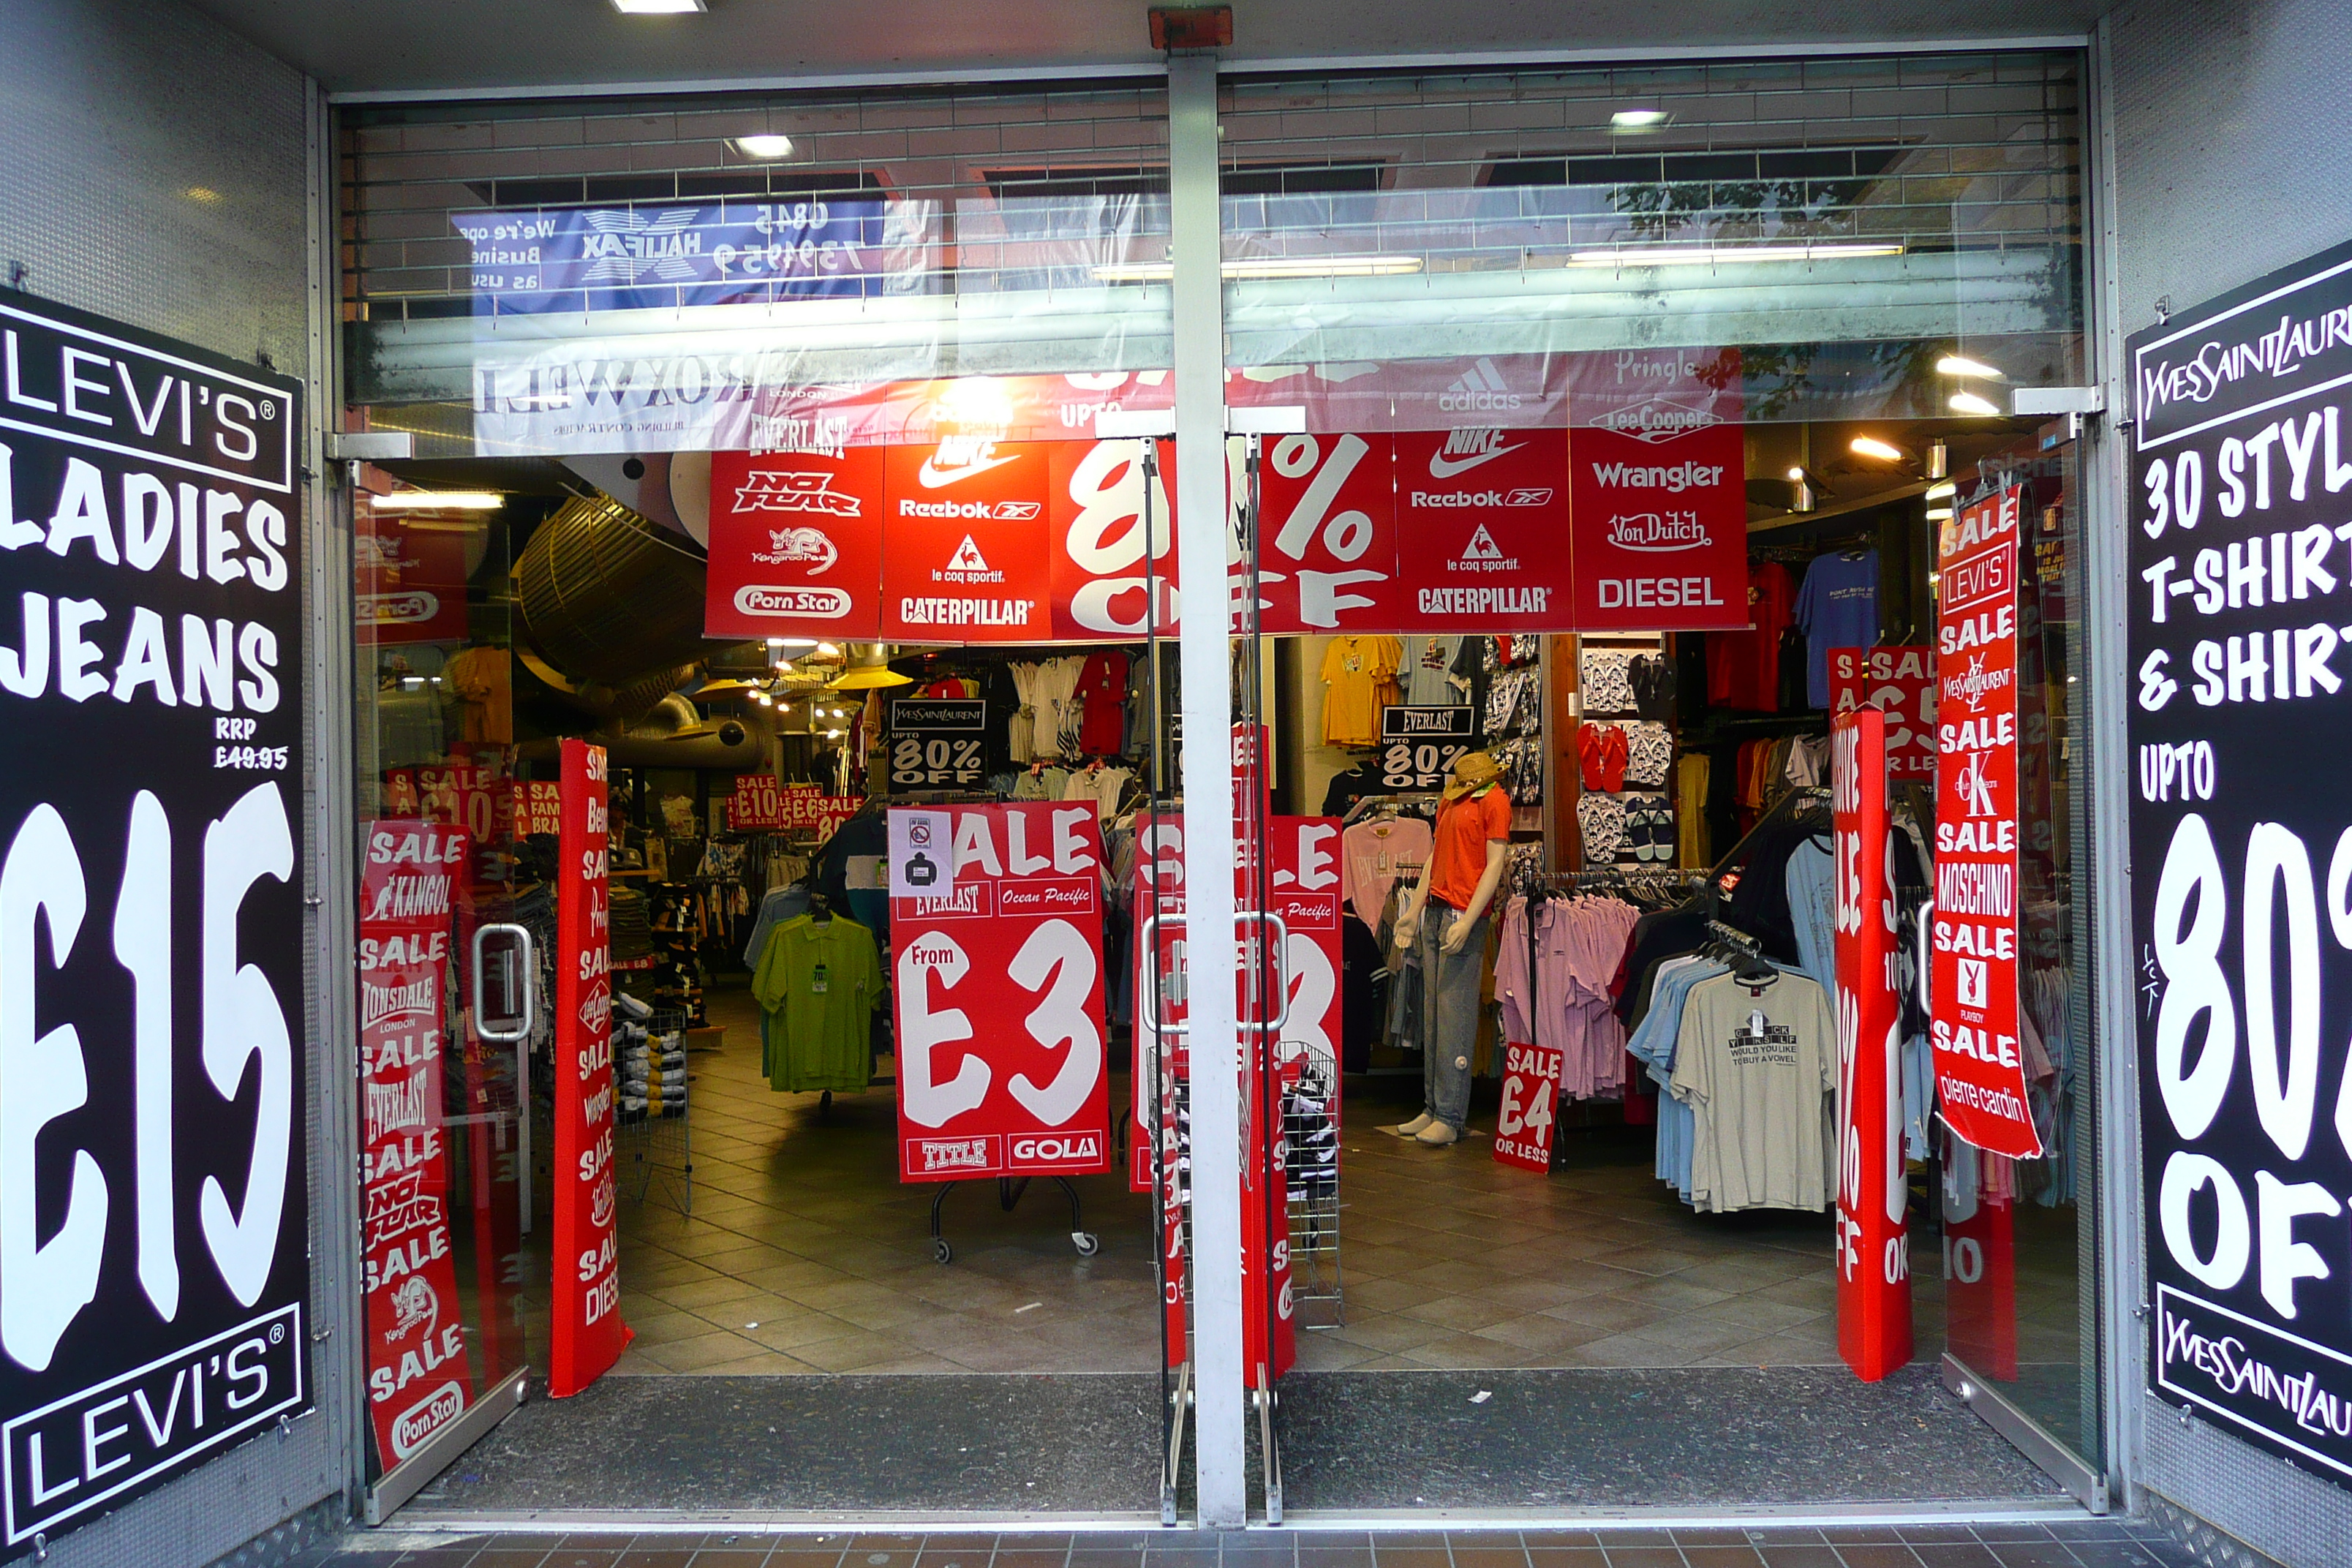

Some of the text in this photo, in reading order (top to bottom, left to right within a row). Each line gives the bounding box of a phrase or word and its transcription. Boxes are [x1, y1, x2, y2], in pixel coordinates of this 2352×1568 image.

[1614, 351, 1695, 385] Pringle
[1439, 391, 1522, 412] adidas
[750, 413, 848, 460] EVERLAST
[1443, 425, 1509, 454] NIKE
[1592, 461, 1724, 493] Wrangler
[2143, 406, 2352, 540] 30 STYL
[900, 500, 992, 519] Reebok
[1411, 490, 1503, 508] Reebok
[0, 443, 288, 591] LADIES
[1940, 497, 2017, 558] SALE
[932, 570, 943, 581] le
[944, 572, 965, 584] coq
[1447, 559, 1458, 571] le
[1460, 561, 1480, 573] coq
[750, 592, 840, 611] Porn Star
[1599, 576, 1725, 608] DIESEL
[1940, 604, 2014, 656] SALE
[0, 591, 279, 714] JEANS
[2138, 621, 2352, 712] & SHIR
[215, 717, 256, 740] RRP
[1403, 710, 1454, 732] EVERLAST
[1940, 711, 2015, 754] SALE
[893, 739, 981, 770] 80%
[421, 770, 491, 791] SALE
[736, 777, 776, 789] SALE
[793, 788, 821, 798] SALE
[892, 770, 983, 784] OFF
[737, 788, 777, 818] £10
[818, 798, 862, 812] SALE
[369, 831, 466, 864] SALE
[952, 806, 1096, 877] ALE
[1937, 819, 2016, 853] SALE
[392, 874, 452, 918] KANGOL
[1002, 887, 1090, 909] Ocean Pacific
[1937, 862, 2012, 918] MOSCHINO
[1288, 902, 1333, 921] Pacific
[358, 930, 448, 970] SALE
[911, 945, 954, 966] From
[1934, 920, 2016, 961] SALE
[380, 1017, 416, 1033] LONDON
[897, 919, 1101, 1128] £3
[1960, 1009, 1984, 1024] PLAYBOY
[356, 1029, 440, 1078] SALE
[1730, 1047, 1759, 1057] WOULD
[1743, 1057, 1759, 1065] BUY
[1768, 1055, 1797, 1063] VOWEL
[1932, 1019, 2019, 1069] SALE
[0, 780, 294, 1372] £15
[1507, 1046, 1561, 1080] SALE
[367, 1066, 427, 1147] EVERLAST
[1499, 1075, 1553, 1148] £4
[1940, 1069, 2027, 1124] pierre cardin
[358, 1127, 442, 1186] SALE
[579, 1126, 613, 1182] SALE
[921, 1139, 987, 1170] TITLE
[1013, 1137, 1098, 1160] GOLA
[1495, 1138, 1549, 1164] OR LESS
[2159, 1150, 2352, 1319] OF
[359, 1225, 449, 1294] SALE
[370, 1323, 464, 1403] SALE
[402, 1394, 457, 1447] Porn Star
